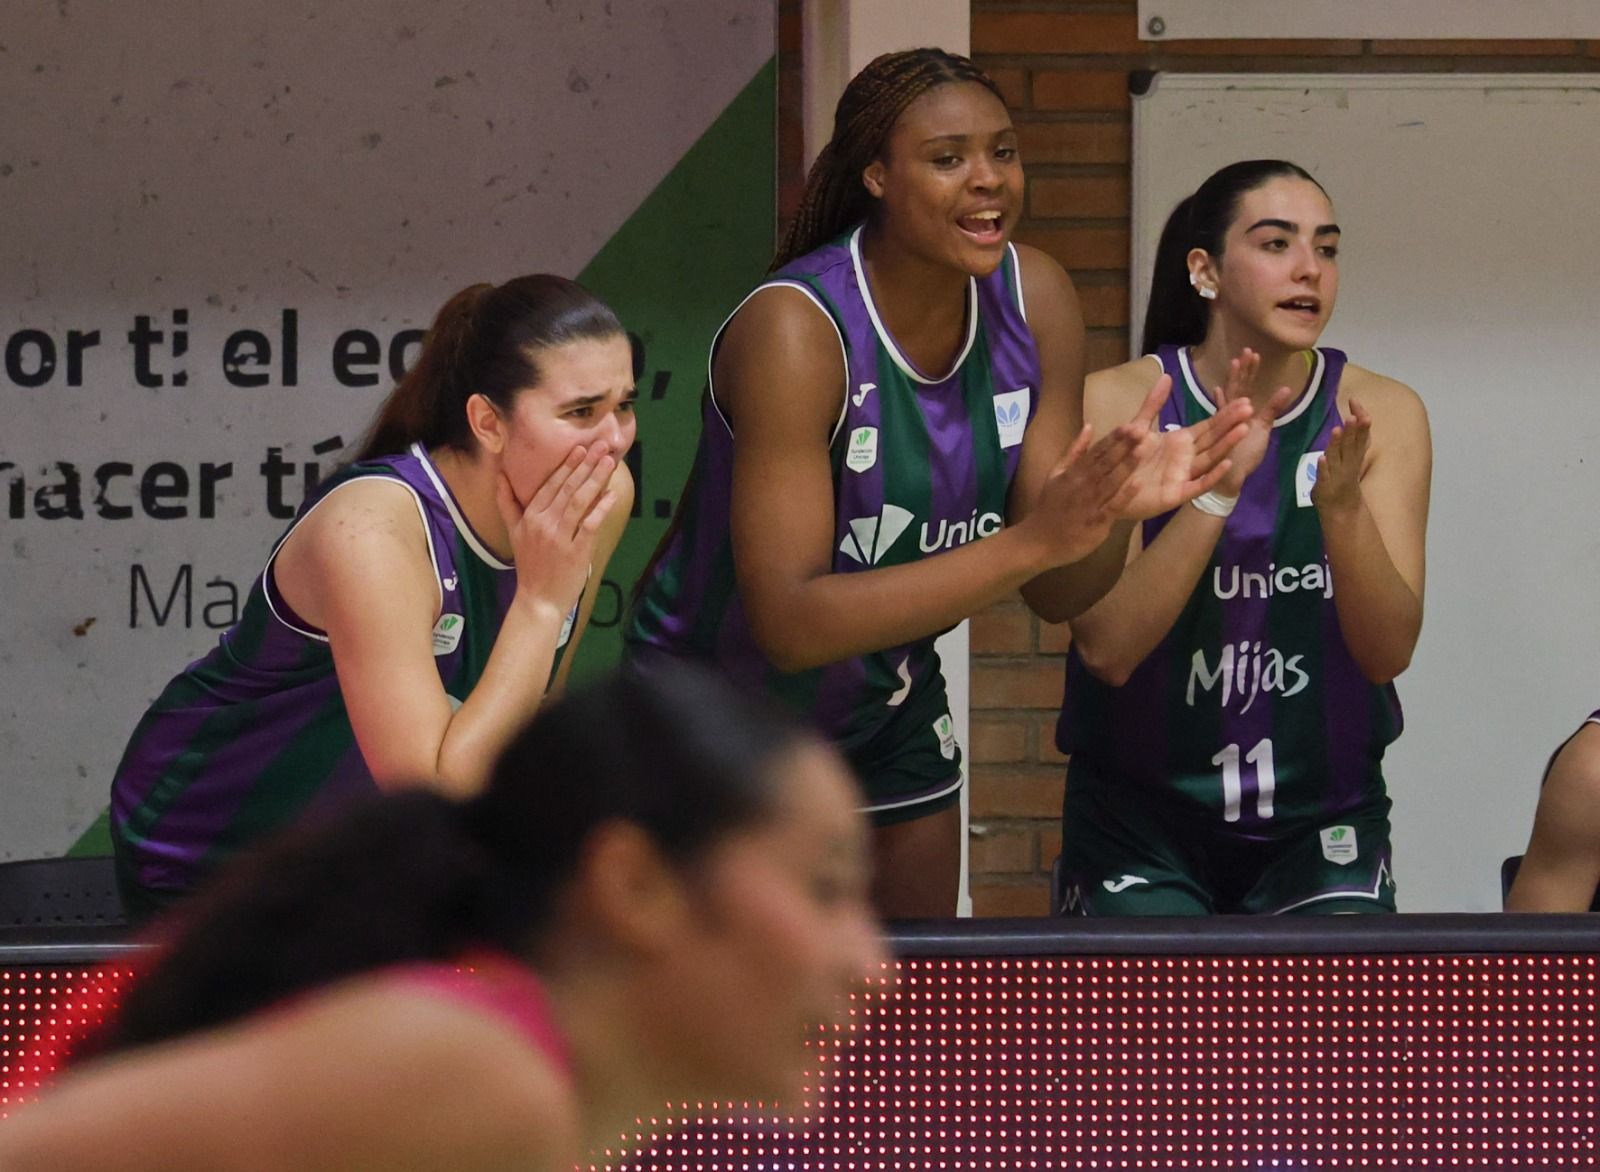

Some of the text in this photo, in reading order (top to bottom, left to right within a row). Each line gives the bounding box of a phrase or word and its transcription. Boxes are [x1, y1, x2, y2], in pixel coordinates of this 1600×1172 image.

[127, 308, 189, 388] ti
[222, 308, 298, 388] el
[918, 508, 1003, 554] Unic
[1185, 640, 1310, 716] Mijas
[1211, 738, 1275, 823] 11
